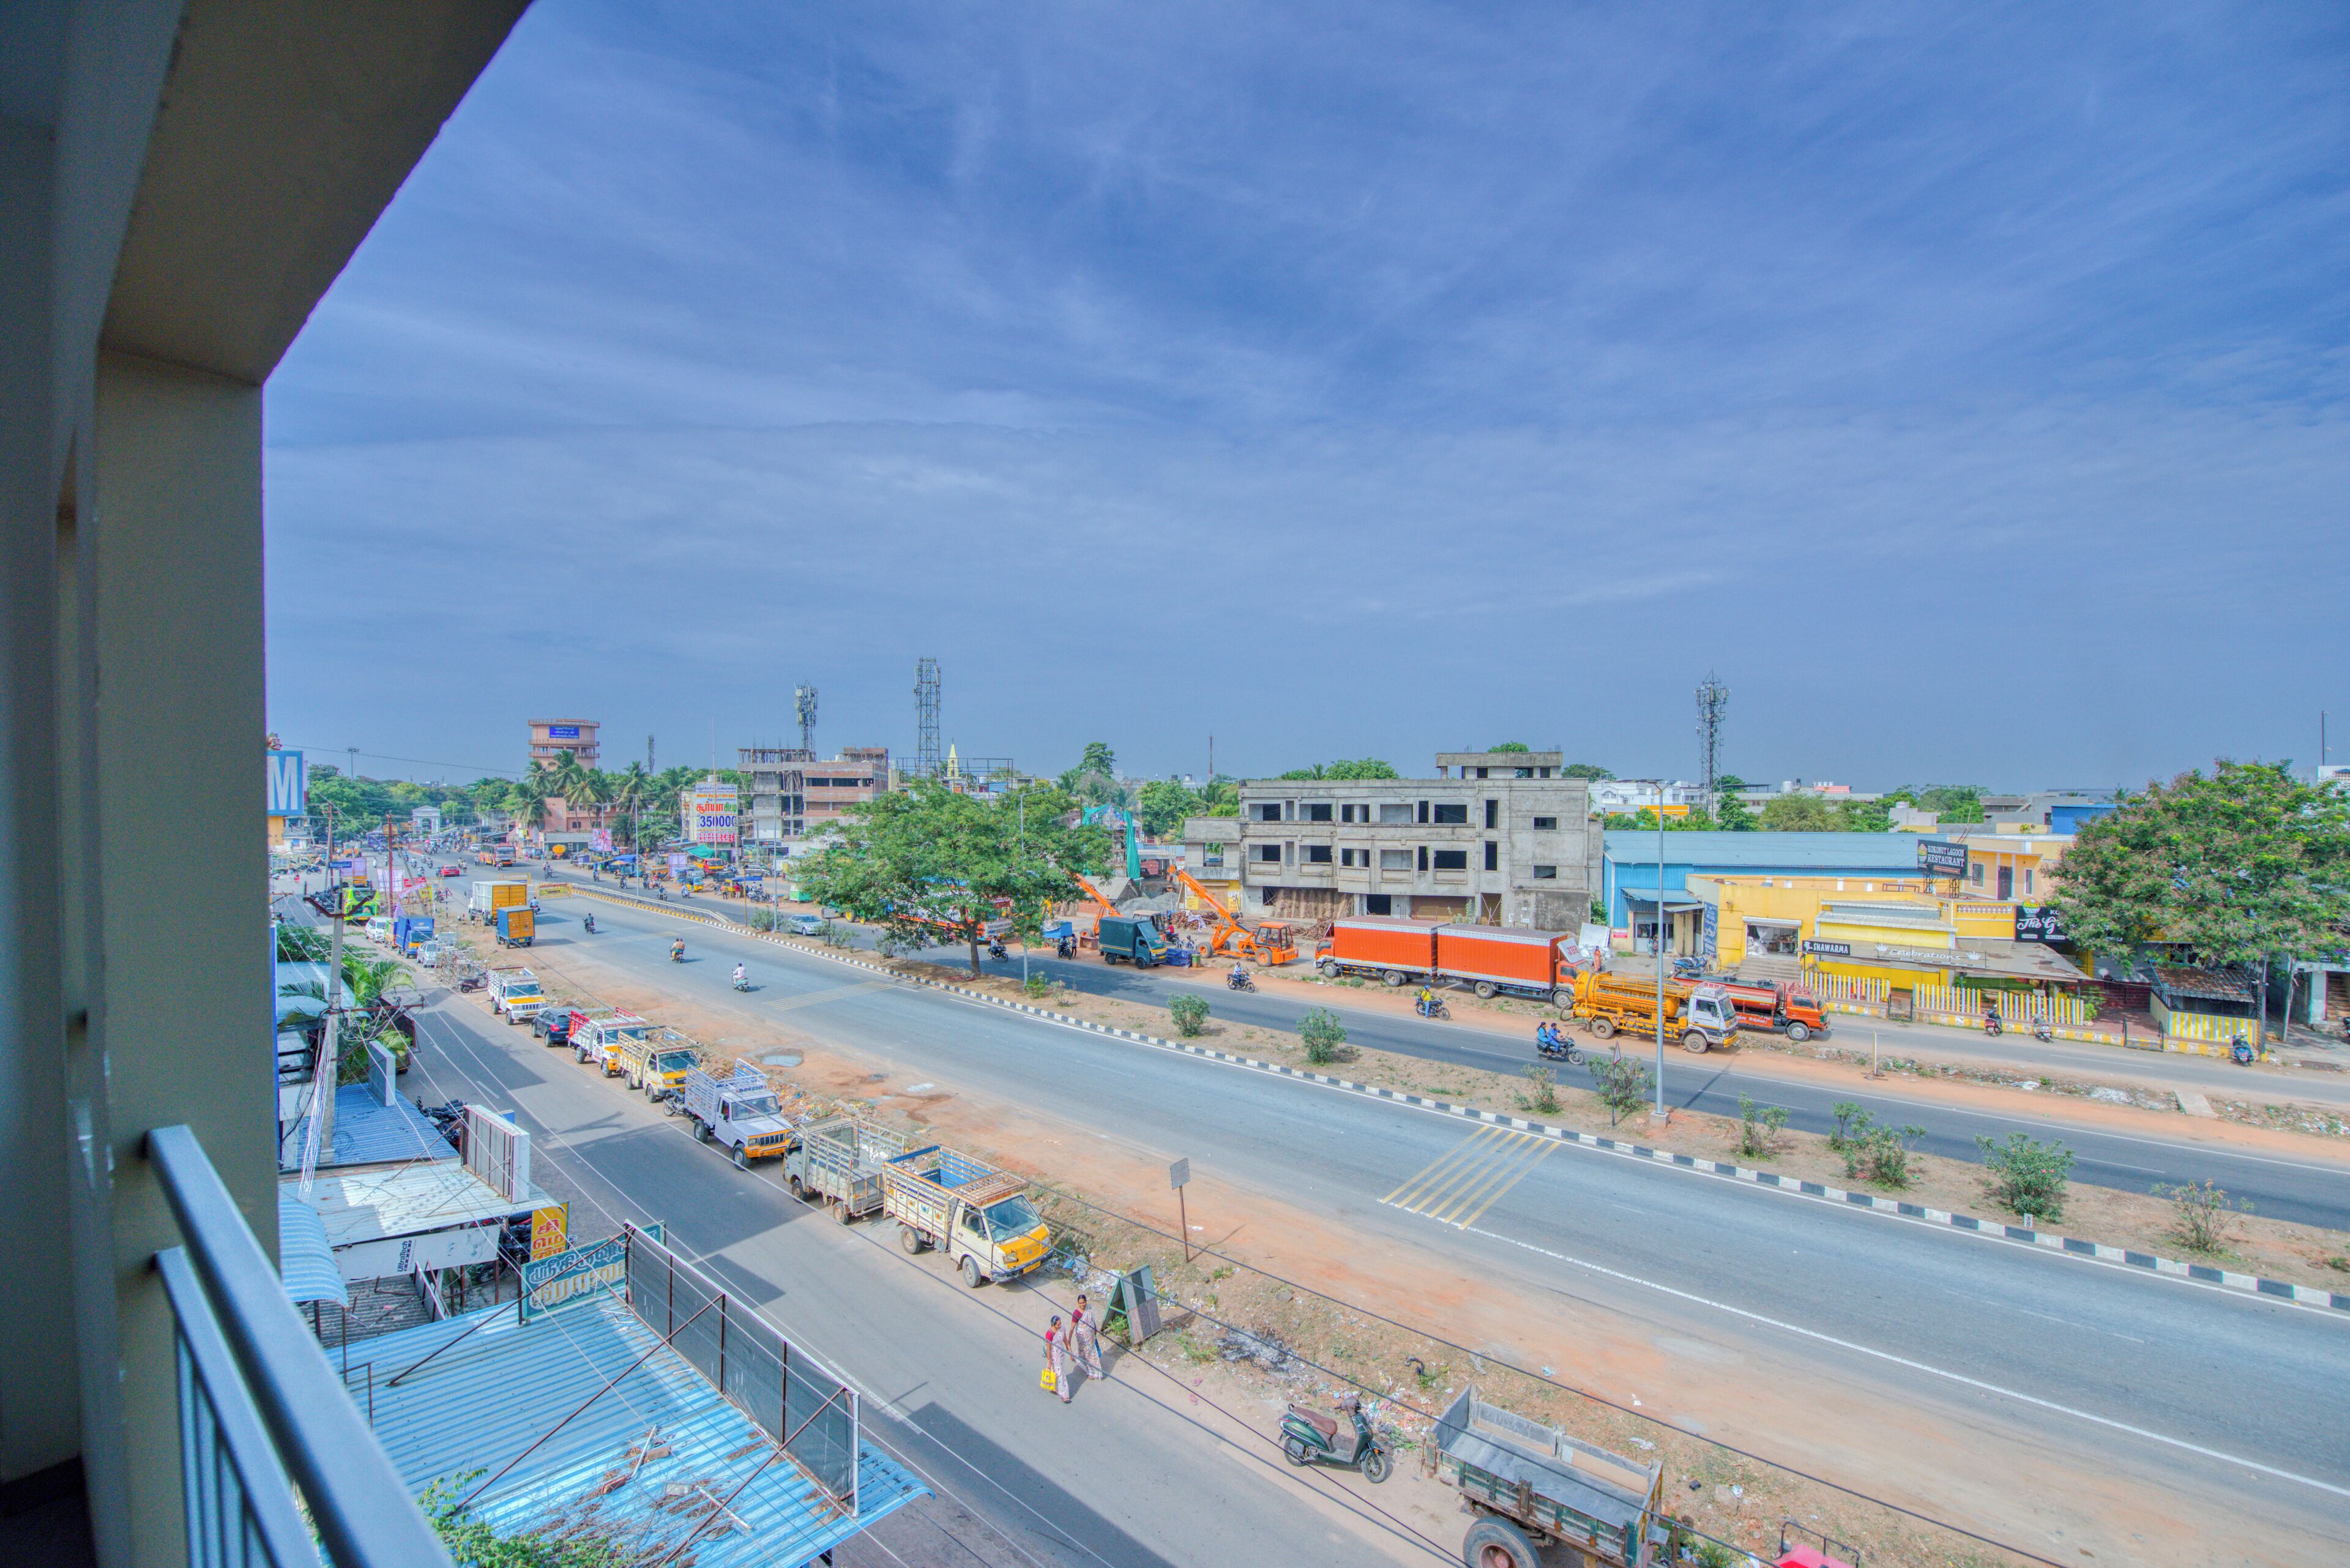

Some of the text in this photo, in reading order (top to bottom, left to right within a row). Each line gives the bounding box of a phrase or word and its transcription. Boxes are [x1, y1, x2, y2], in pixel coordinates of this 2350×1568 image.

[1927, 845, 1964, 857] KOKONUT LAGOON
[1927, 854, 1964, 867] RESTAURANT
[2016, 917, 2042, 930] The
[1813, 943, 1848, 954] SHAWARMA
[1889, 949, 1961, 960] Celebrations
[397, 1241, 409, 1272] UltraTech
